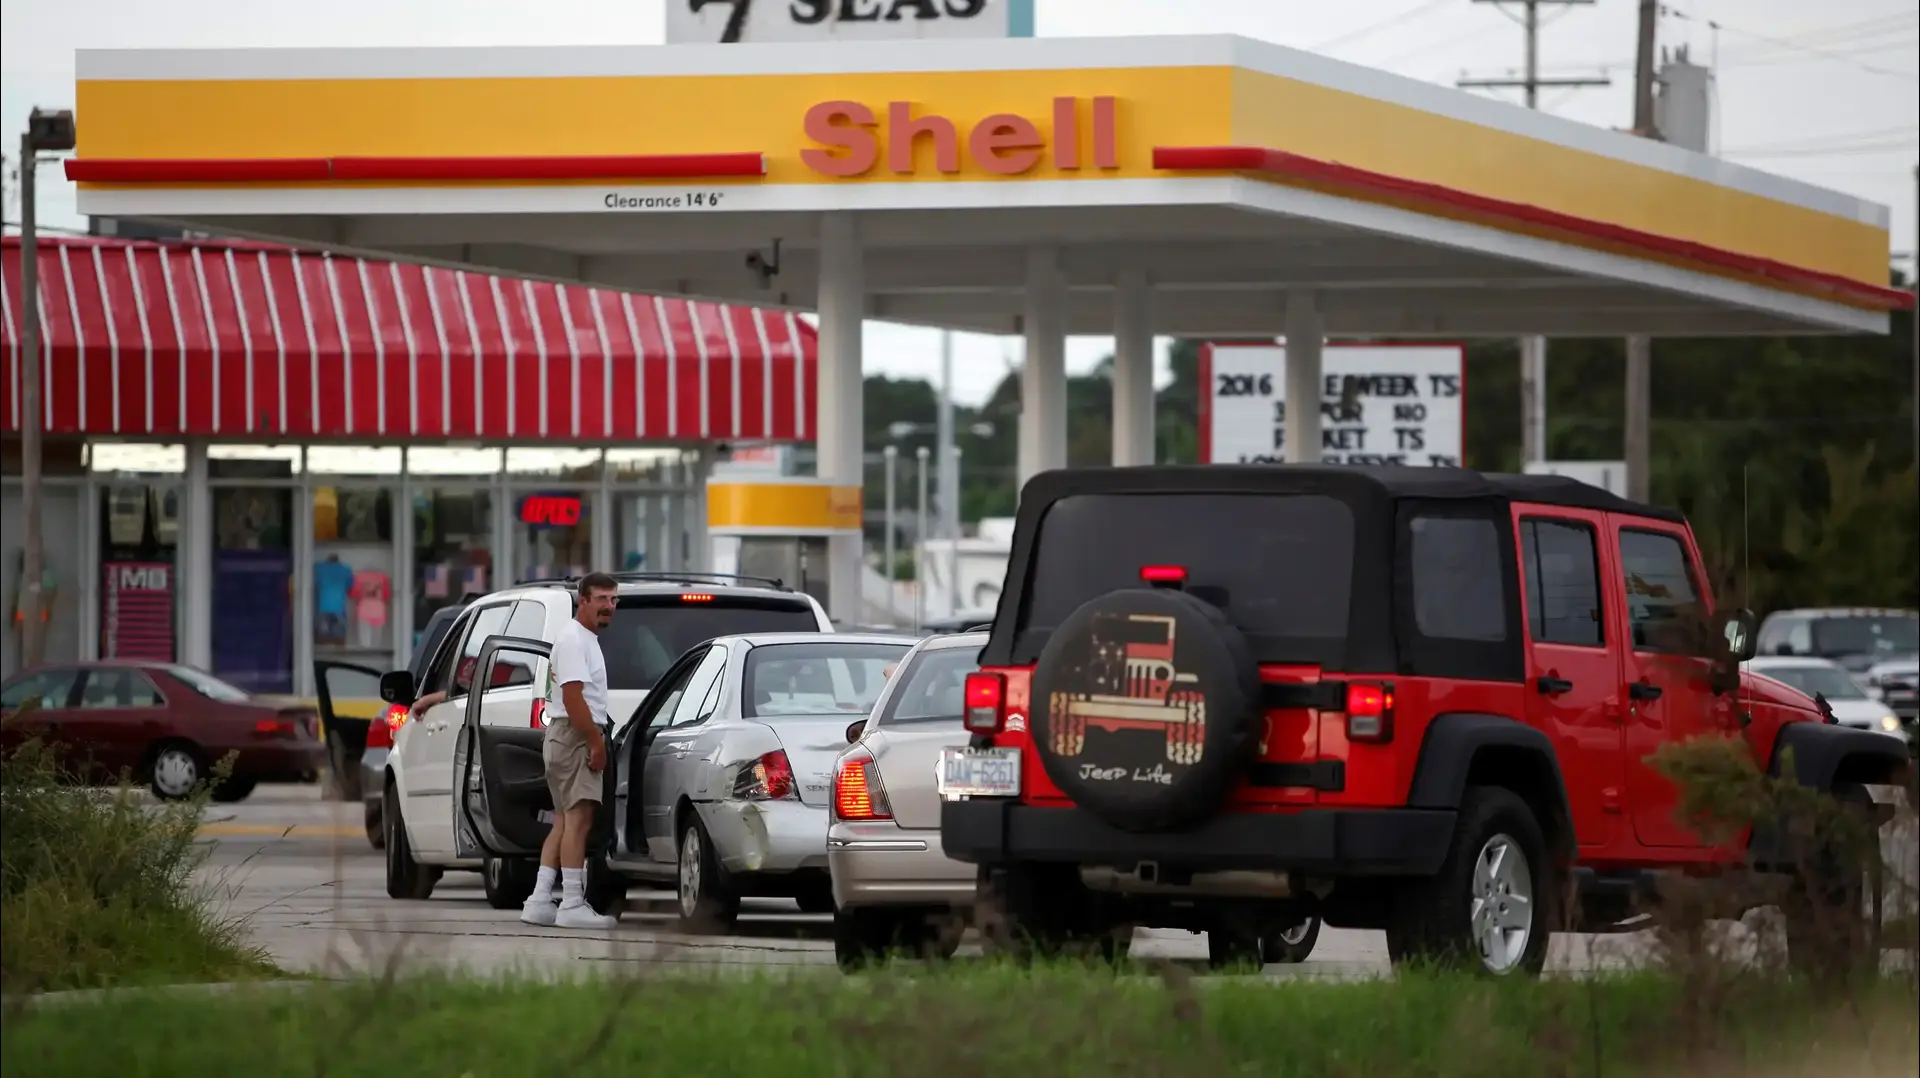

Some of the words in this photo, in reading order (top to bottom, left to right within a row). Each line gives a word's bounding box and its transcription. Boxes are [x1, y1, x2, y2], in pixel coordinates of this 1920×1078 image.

[800, 95, 1118, 177] Shell
[604, 193, 681, 208] Clearance
[1217, 373, 1273, 396] 2016
